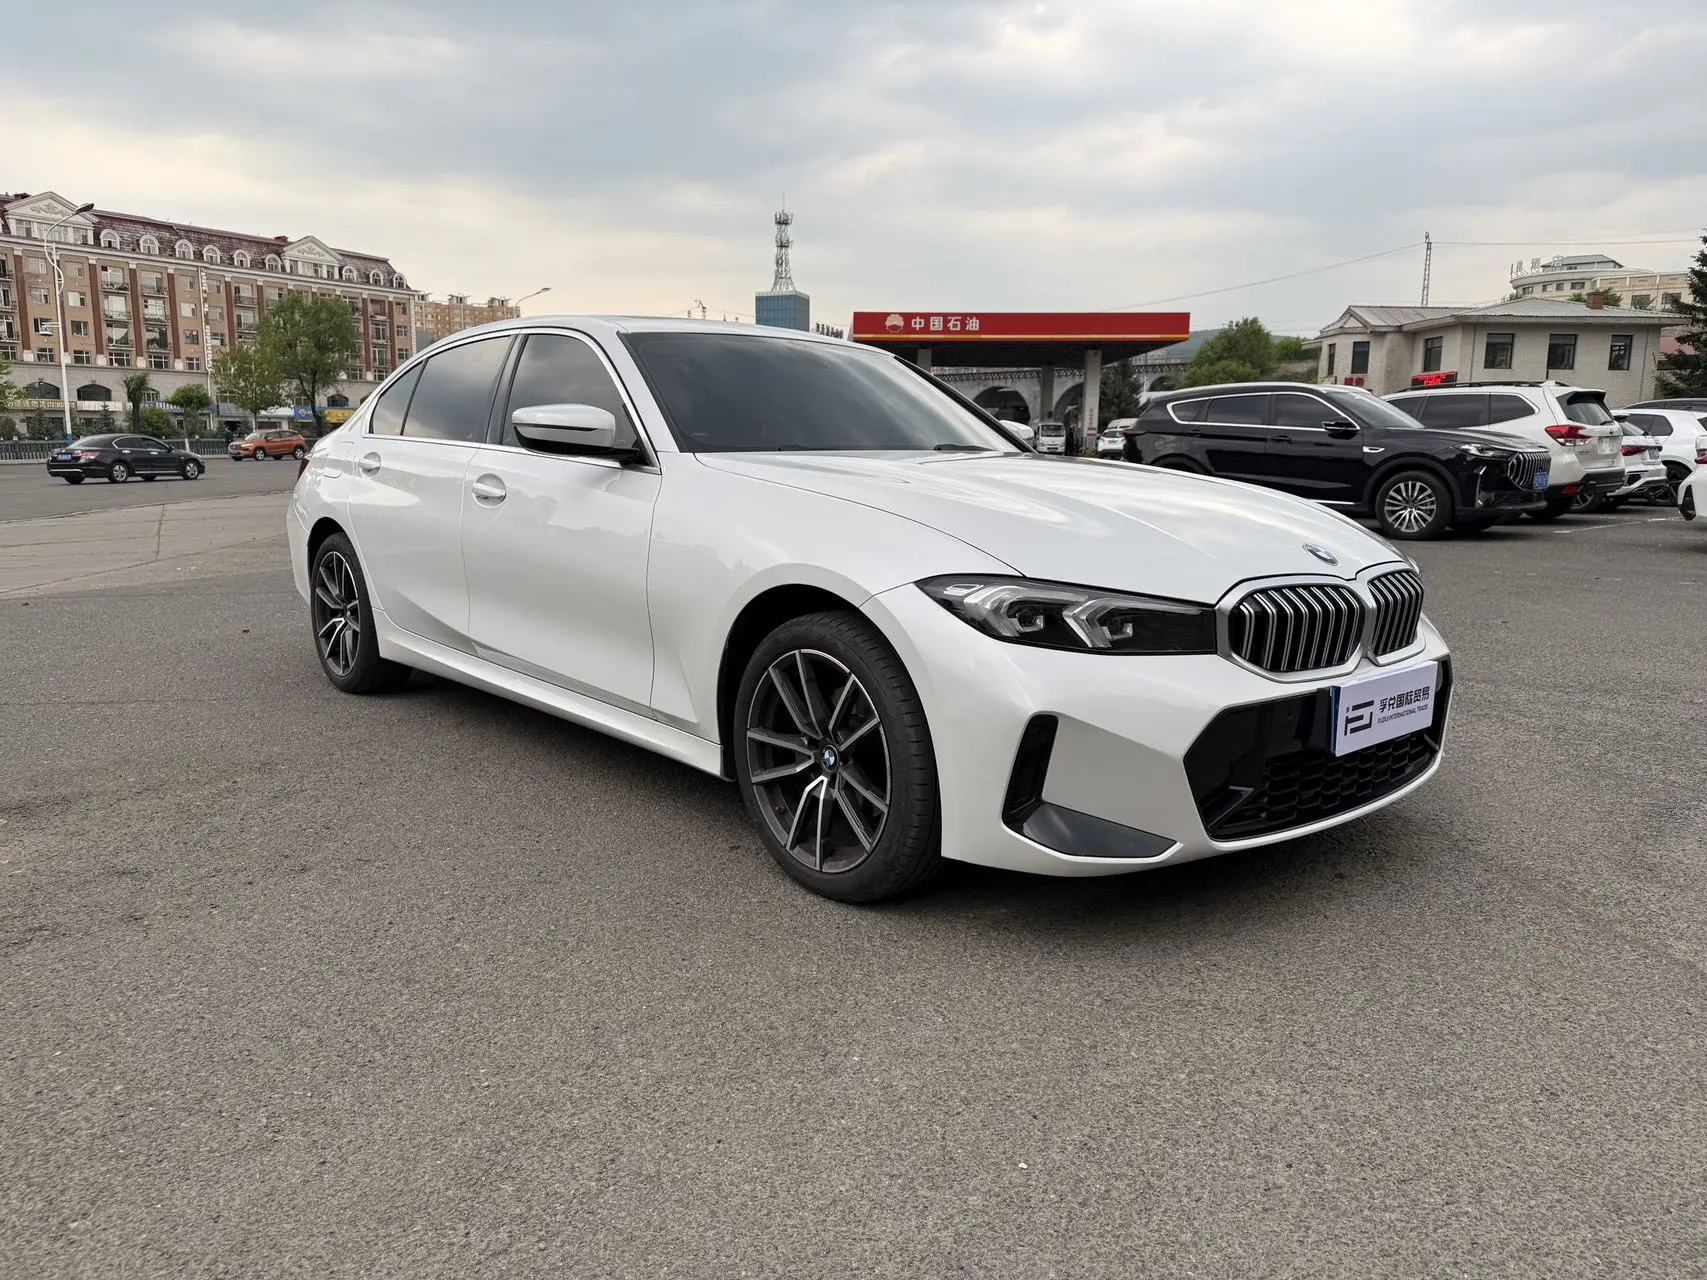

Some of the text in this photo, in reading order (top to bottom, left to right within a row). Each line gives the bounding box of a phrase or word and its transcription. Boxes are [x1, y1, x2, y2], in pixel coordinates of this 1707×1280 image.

[911, 316, 980, 331] 中国石油
[1379, 686, 1430, 713] 孚兑国际贸易
[1389, 708, 1416, 720] INTERNATIONAL
[1416, 703, 1428, 712] TRADE
